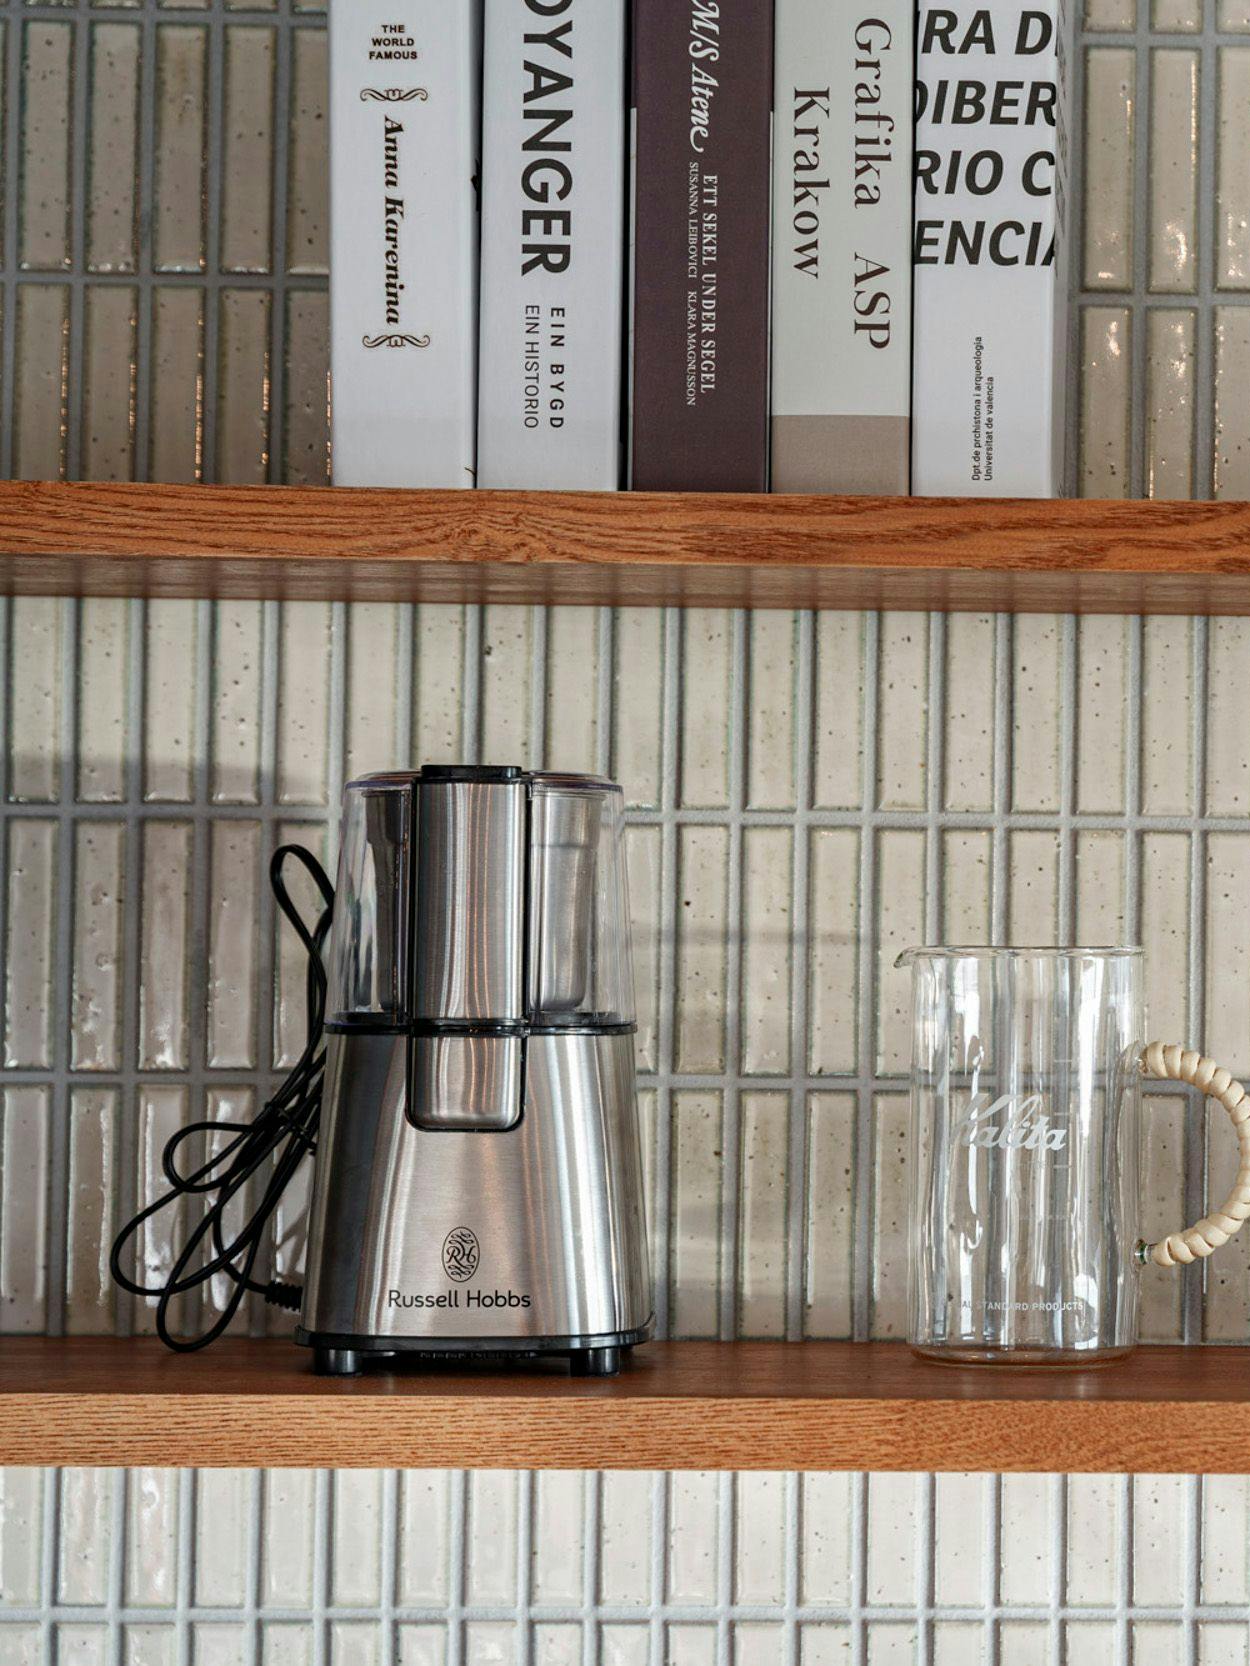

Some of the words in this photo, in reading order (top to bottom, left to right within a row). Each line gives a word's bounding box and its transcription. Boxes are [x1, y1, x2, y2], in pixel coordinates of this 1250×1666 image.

[368, 50, 418, 60] FAMOUS
[371, 37, 415, 47] WORLD
[381, 24, 405, 33] THE
[1014, 10, 1058, 57] D
[689, 62, 720, 153] Atene
[854, 18, 894, 208] Grafika
[384, 115, 404, 188] Anna
[521, 0, 574, 276] YANGER
[688, 161, 699, 215] SUSANNA
[703, 174, 718, 207] ETT
[793, 87, 830, 279] Krakow
[384, 196, 405, 324] Karenina
[688, 219, 698, 278] LEIBOVICI
[702, 212, 717, 266] SEKEL
[525, 305, 540, 334] EIN
[550, 307, 565, 347] EIN
[687, 291, 697, 330] KLARA
[701, 273, 717, 333] UNDER
[853, 252, 891, 349] ASP
[524, 341, 540, 429] HISTORIO
[686, 332, 697, 406] MAGNUSSON
[700, 339, 716, 394] SEGEL
[973, 336, 984, 392] arqueologia
[549, 365, 565, 429] BYGD
[984, 376, 994, 415] valencia
[984, 416, 994, 430] de
[984, 431, 993, 481] Universitat
[951, 1093, 1067, 1151] Kalita
[388, 1289, 460, 1308] Russell
[466, 1289, 531, 1308] Hobbs
[1032, 1302, 1084, 1312] PRODUCTS
